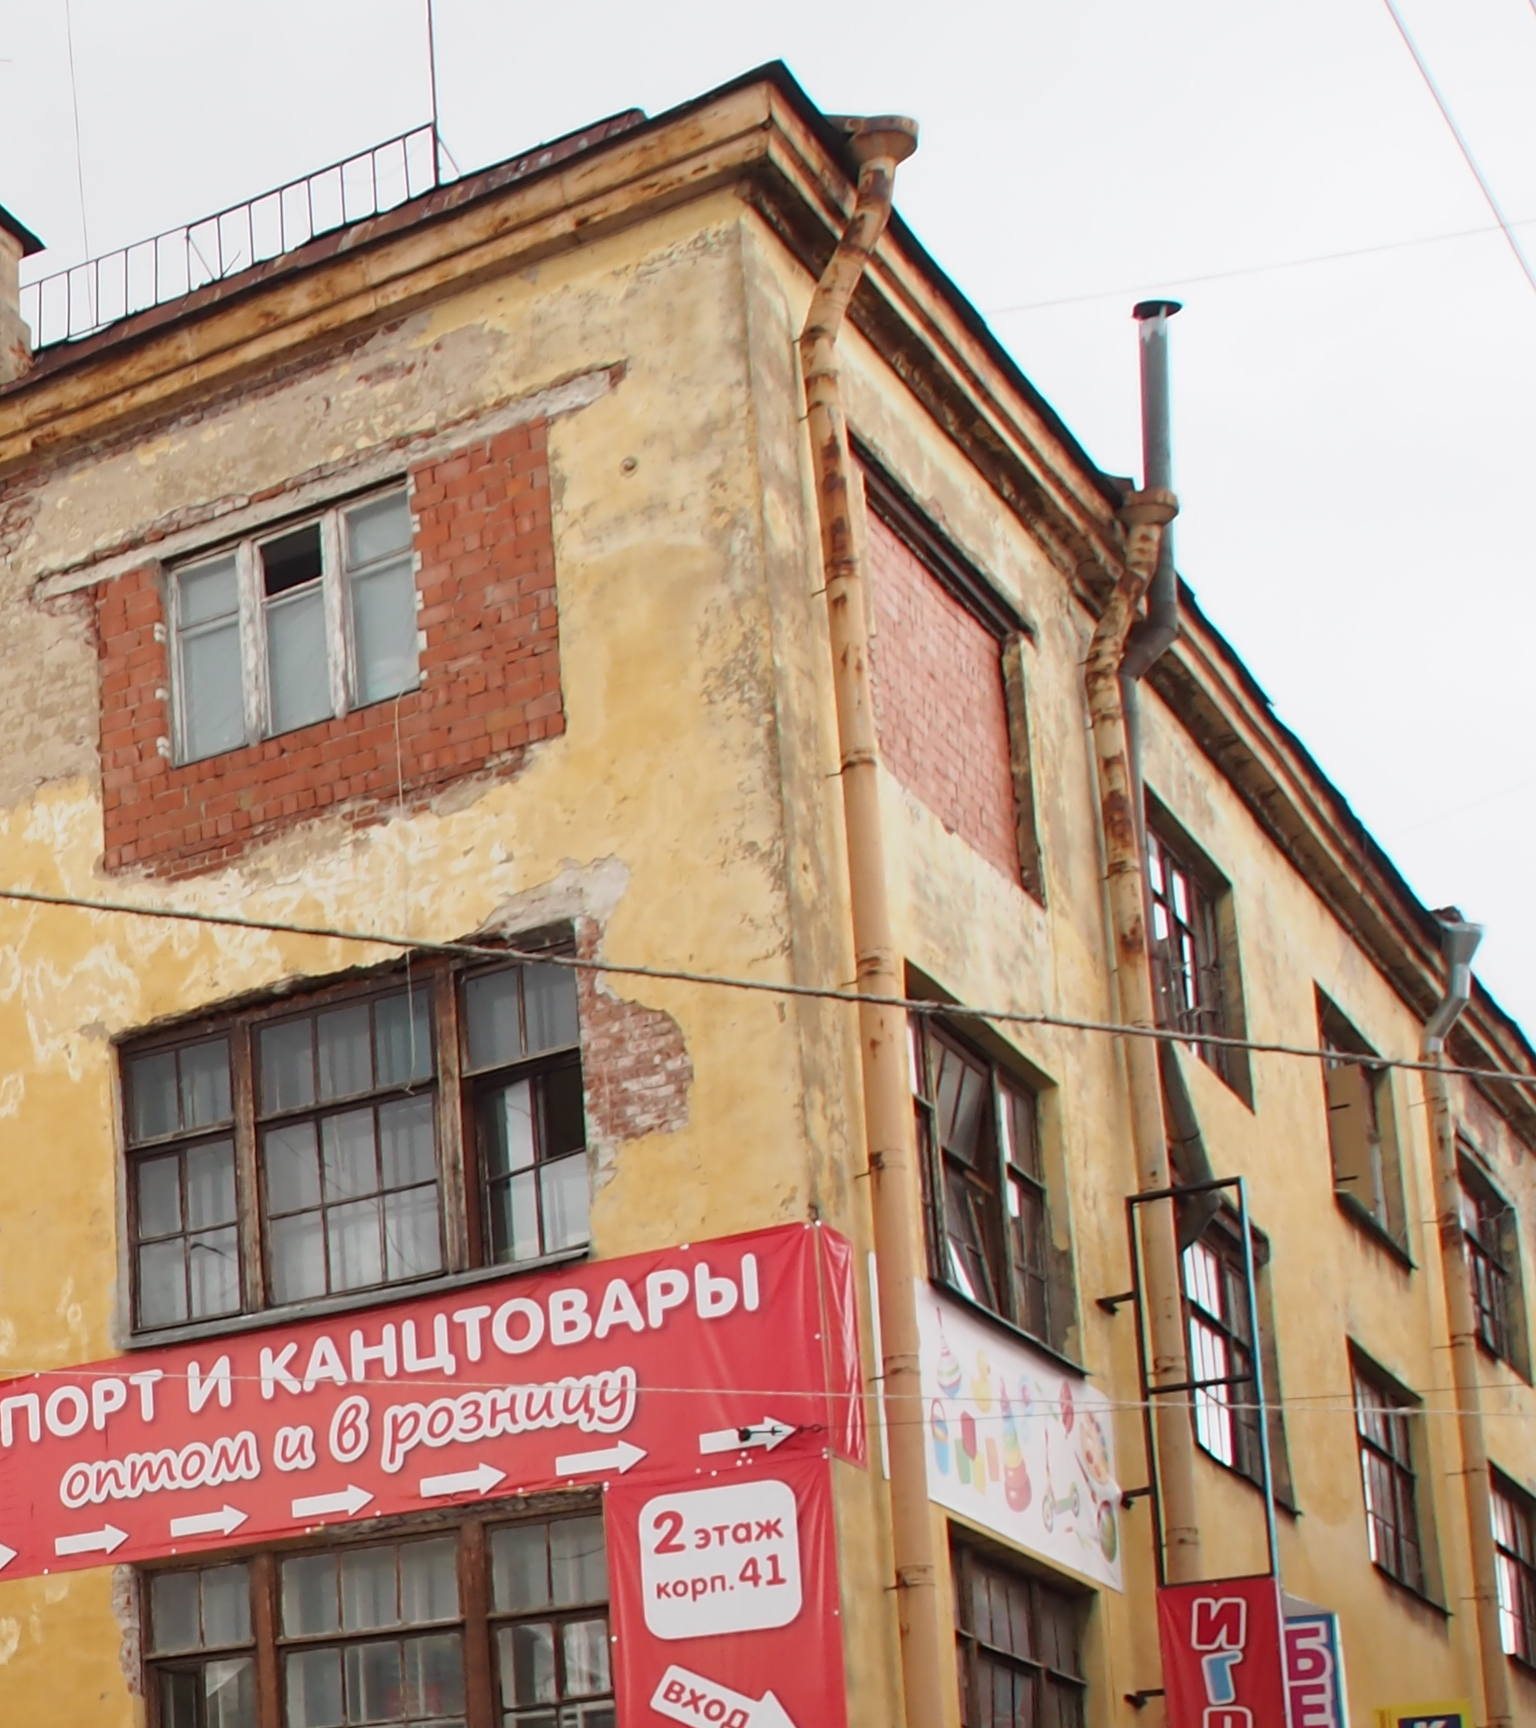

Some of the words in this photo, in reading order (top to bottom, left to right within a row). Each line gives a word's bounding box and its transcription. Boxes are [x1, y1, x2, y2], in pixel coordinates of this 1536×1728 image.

[187, 1353, 232, 1414] И
[259, 1251, 761, 1402] КАНЦТОВАРЫ
[59, 1430, 259, 1511] оптом
[273, 1423, 317, 1470] и
[328, 1392, 371, 1467] в
[378, 1366, 638, 1476] розницу
[652, 1510, 686, 1555] 2
[694, 1517, 784, 1549] этаж
[656, 1574, 735, 1602] корп.
[738, 1554, 786, 1587] 41
